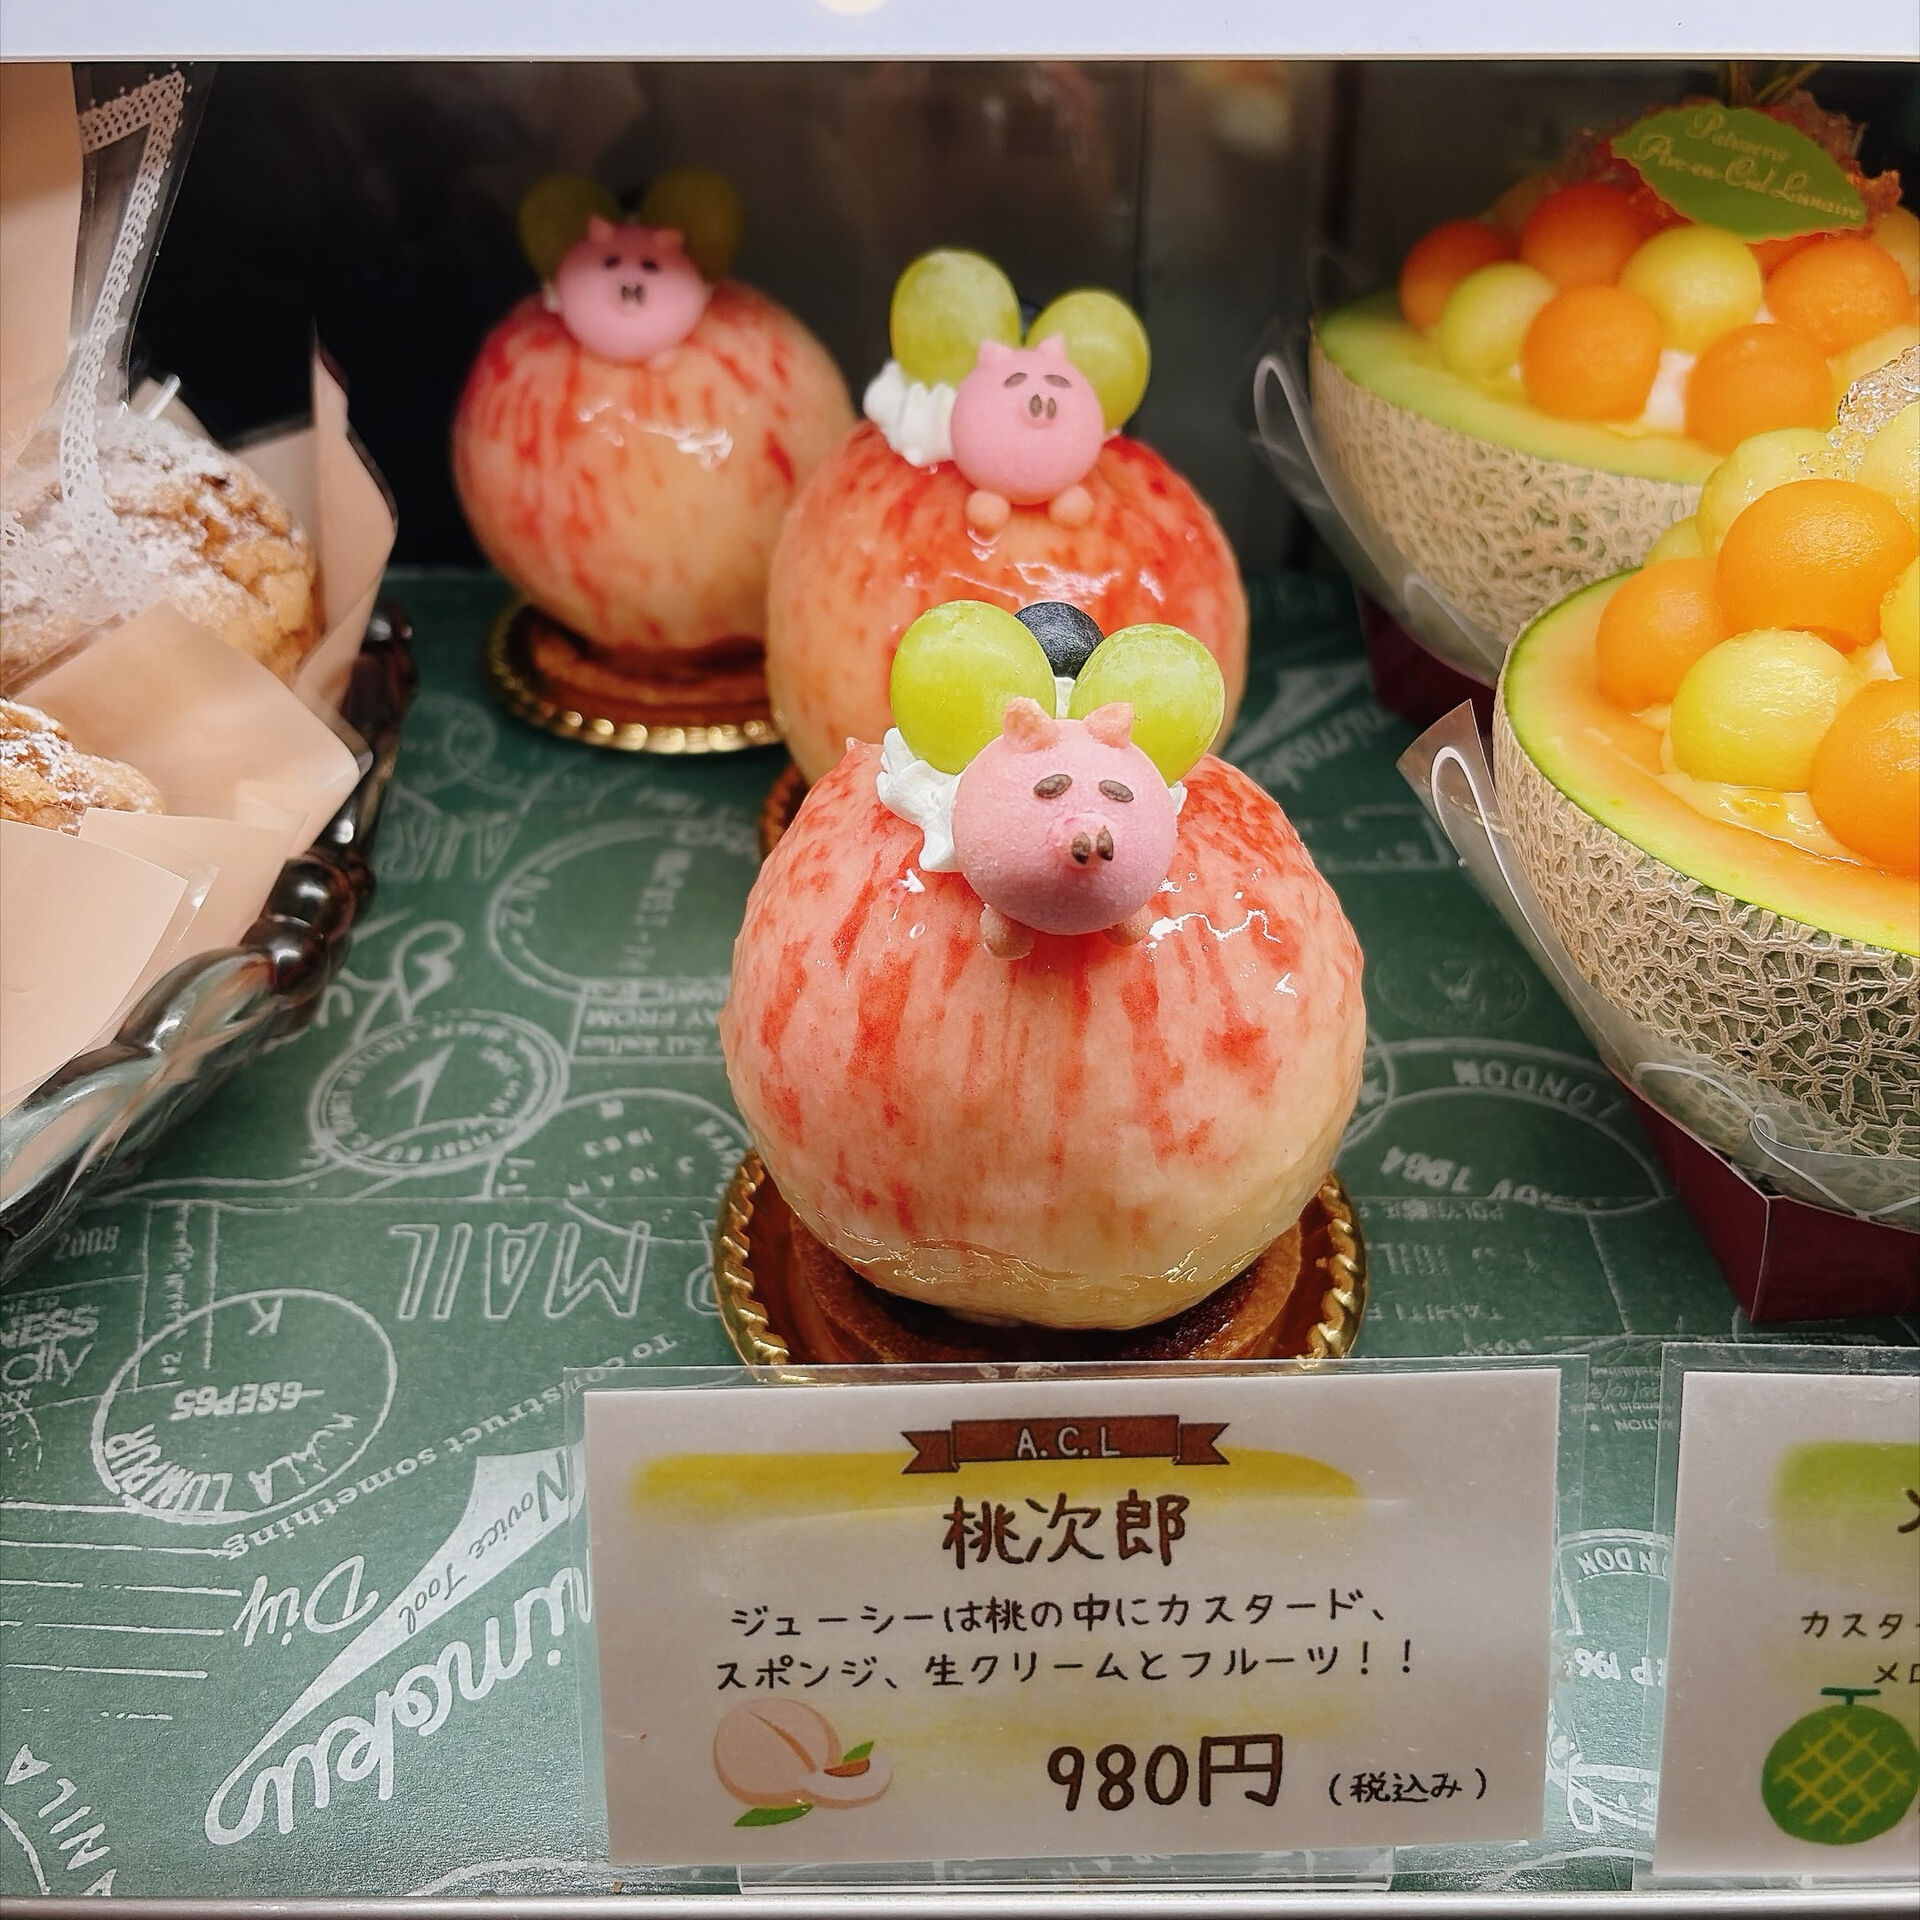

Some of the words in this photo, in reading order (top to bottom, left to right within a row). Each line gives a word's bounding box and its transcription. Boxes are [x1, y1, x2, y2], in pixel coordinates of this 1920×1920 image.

[388, 1220, 652, 1321] MAIL
[1016, 1425, 1121, 1458] A.C.L
[222, 1447, 434, 1562] something
[942, 1488, 1191, 1570] 桃次郎
[398, 1566, 469, 1634] Tool
[730, 1587, 1386, 1638] ジューシーは桃の中にカスタード、
[1046, 1732, 1284, 1812] 980円
[1327, 1768, 1489, 1806] (税込み)
